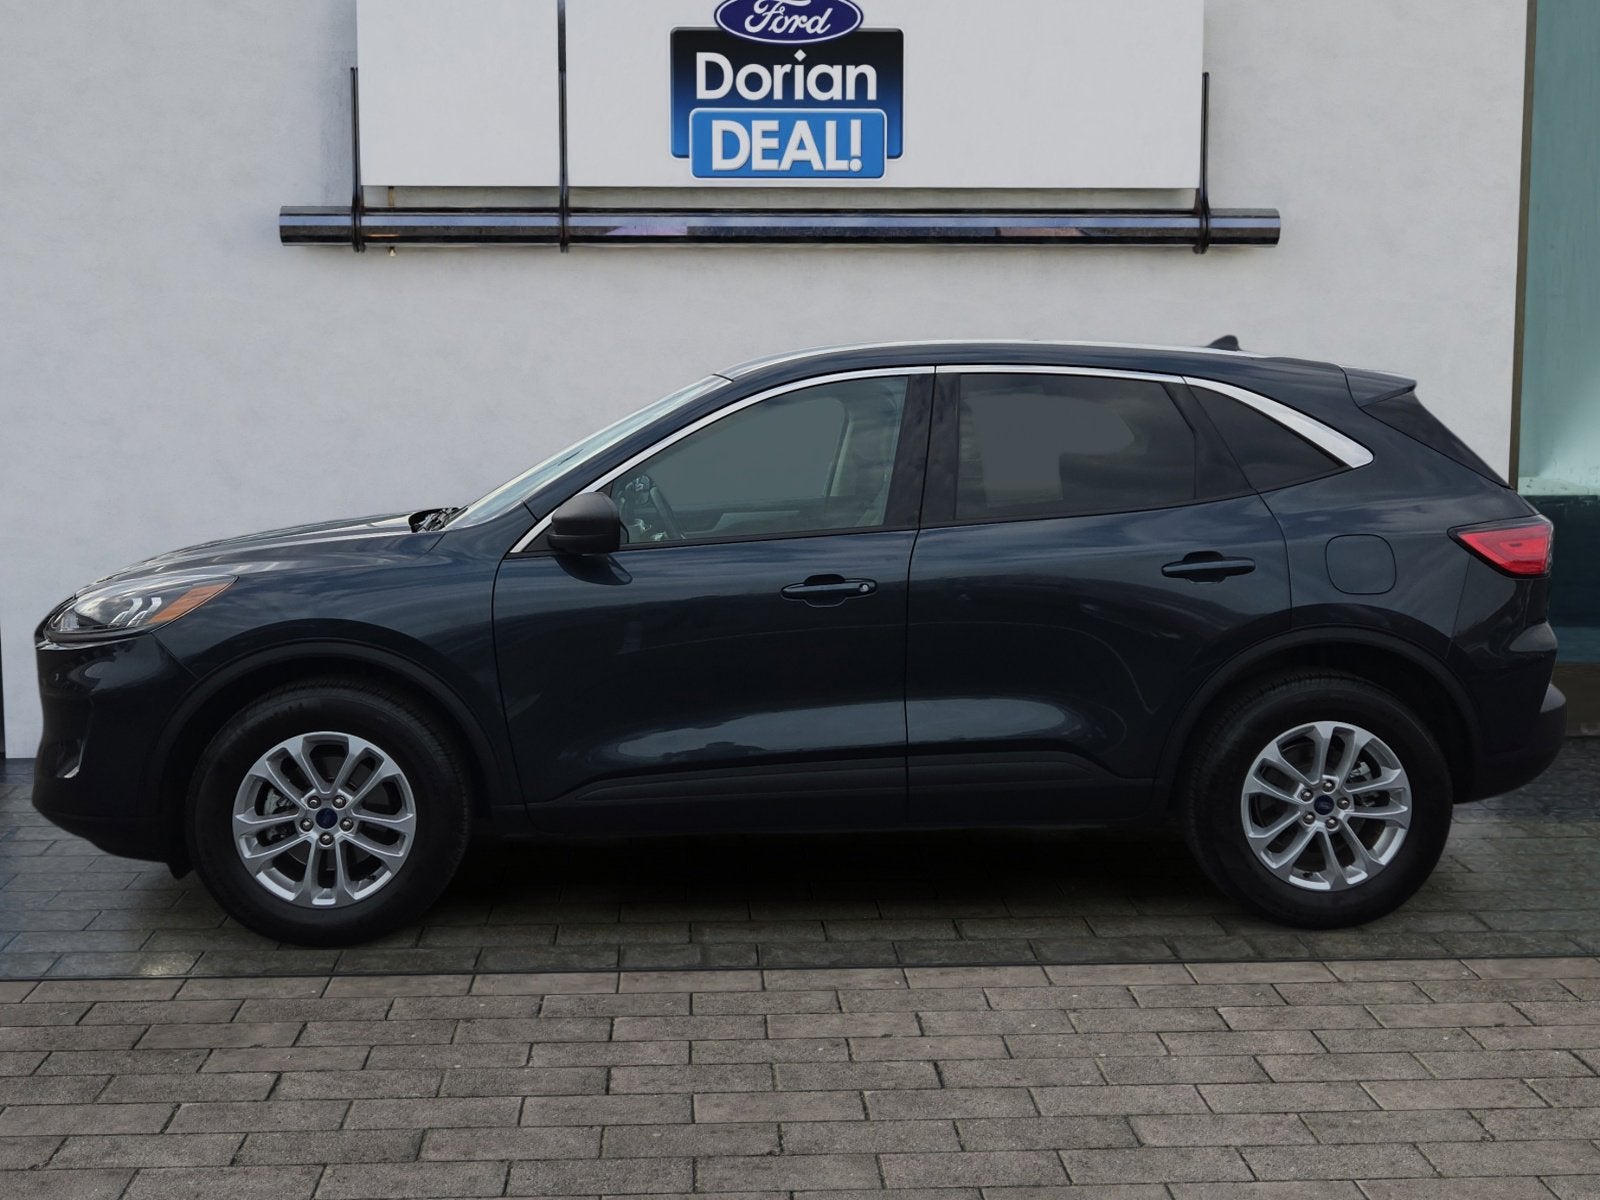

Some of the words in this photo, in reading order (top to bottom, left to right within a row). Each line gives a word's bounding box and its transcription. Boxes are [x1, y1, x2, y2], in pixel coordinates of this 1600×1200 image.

[744, 0, 833, 34] Ford
[696, 49, 877, 101] Dorian
[712, 119, 863, 172] DEAL!
